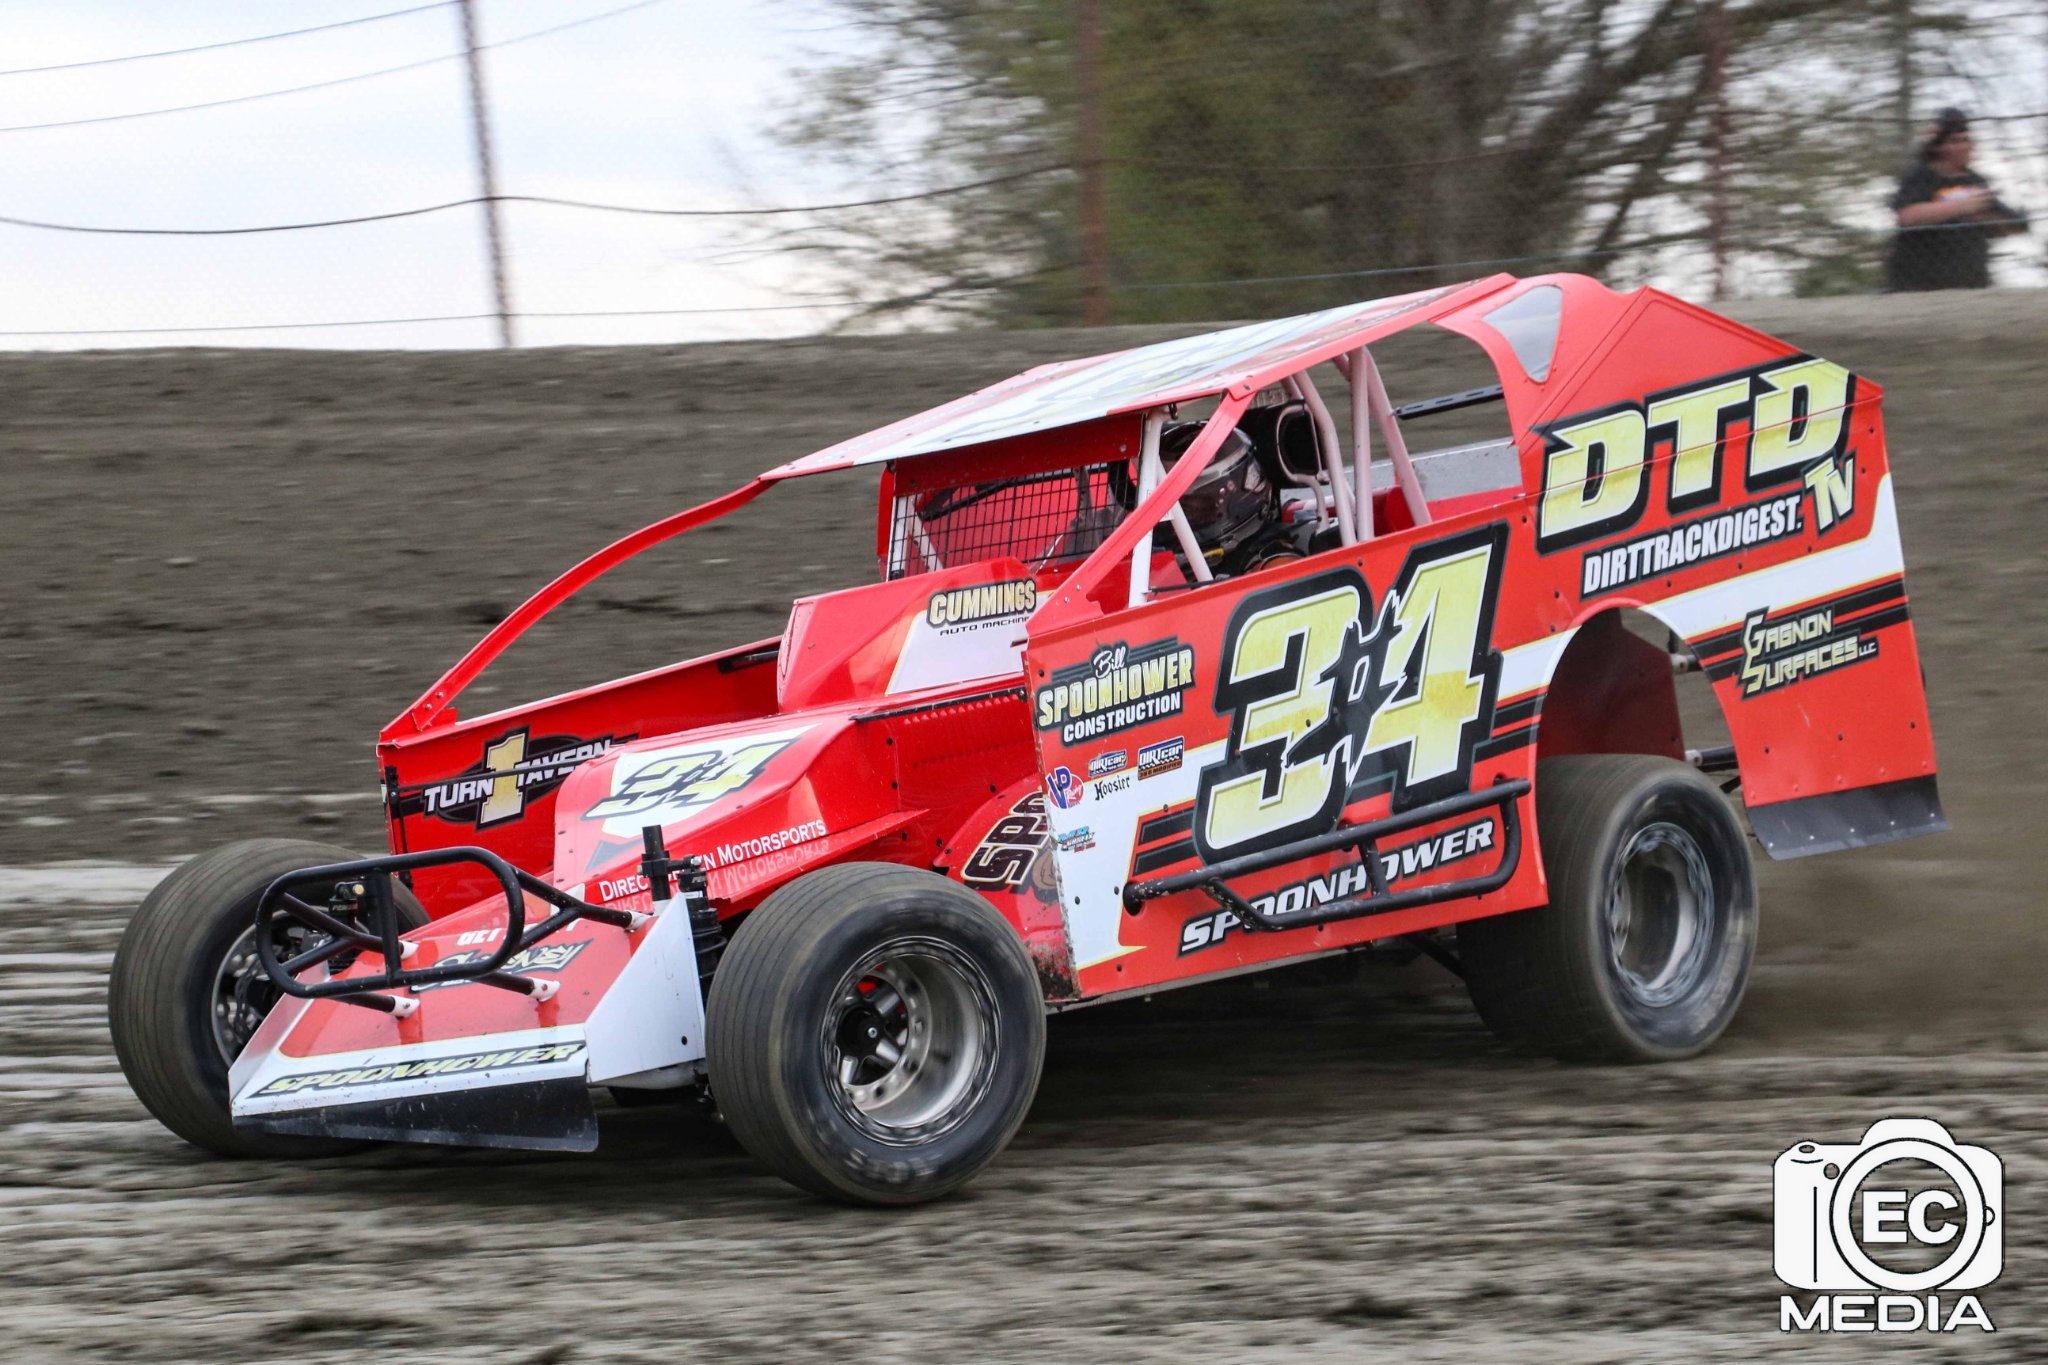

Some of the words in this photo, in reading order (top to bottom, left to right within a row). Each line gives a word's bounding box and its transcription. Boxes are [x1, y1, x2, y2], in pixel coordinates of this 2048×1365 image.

[1541, 358, 1850, 538] DTD
[1805, 458, 1854, 531] TV
[930, 580, 1036, 625] CUMMINGS
[940, 624, 978, 636] AUTO
[1743, 610, 1832, 657] GAGNON
[1093, 646, 1126, 678] Bill
[1742, 635, 1859, 694] SURFACES
[1038, 649, 1192, 727] SPOONHOWER
[1205, 544, 1492, 849] 34
[1063, 692, 1181, 743] CONSTRUCTION
[424, 777, 496, 812] TURN
[1046, 766, 1072, 809] VP
[1094, 775, 1130, 801] Hoosier
[259, 1042, 584, 1094] SPOONHOWER
